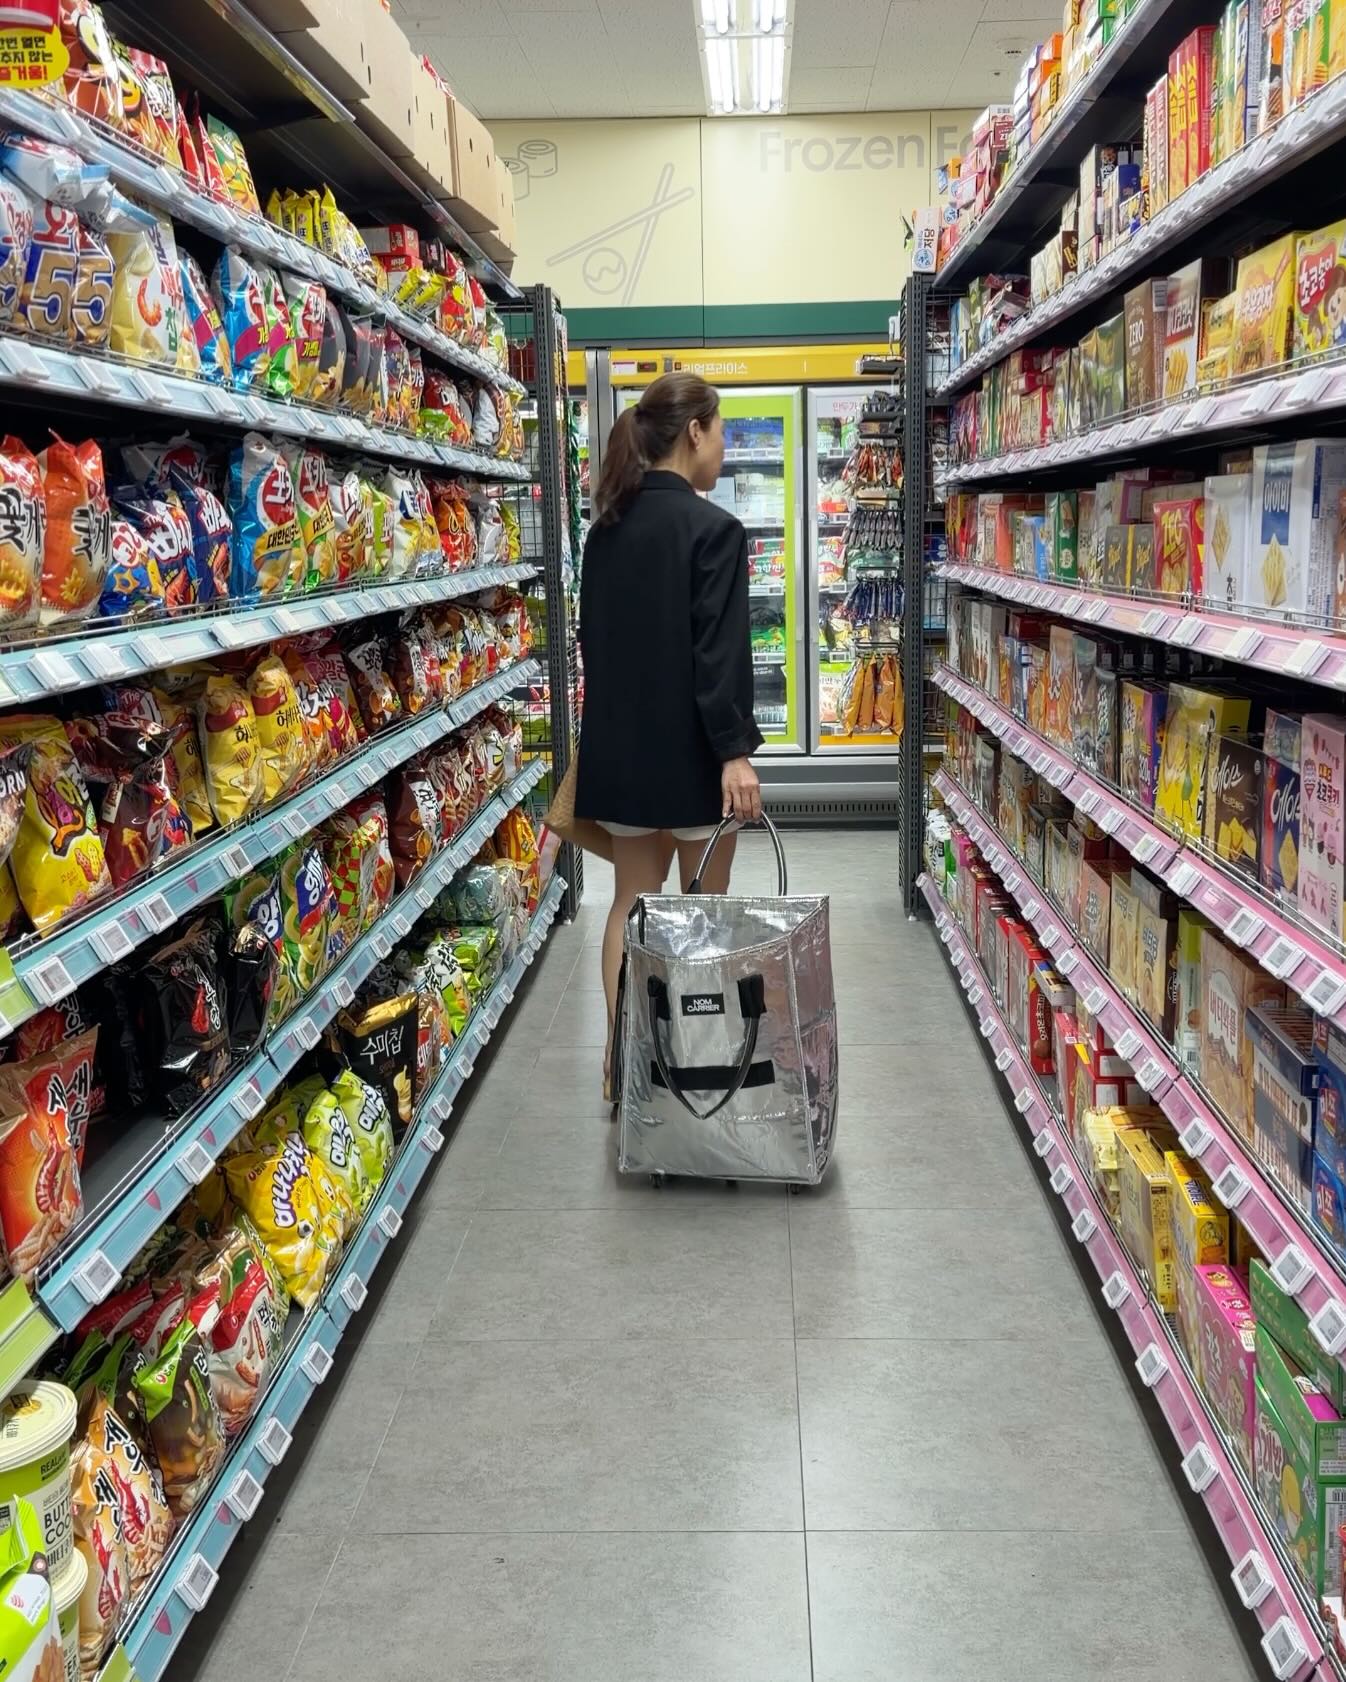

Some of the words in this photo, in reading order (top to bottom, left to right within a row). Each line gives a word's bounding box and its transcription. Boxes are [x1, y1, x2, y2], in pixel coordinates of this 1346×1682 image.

[759, 128, 926, 173] Frozen
[1129, 319, 1144, 348] ZERO
[687, 1003, 720, 1012] CARRIER
[693, 998, 713, 1006] NOM
[360, 1025, 405, 1066] 수미칩
